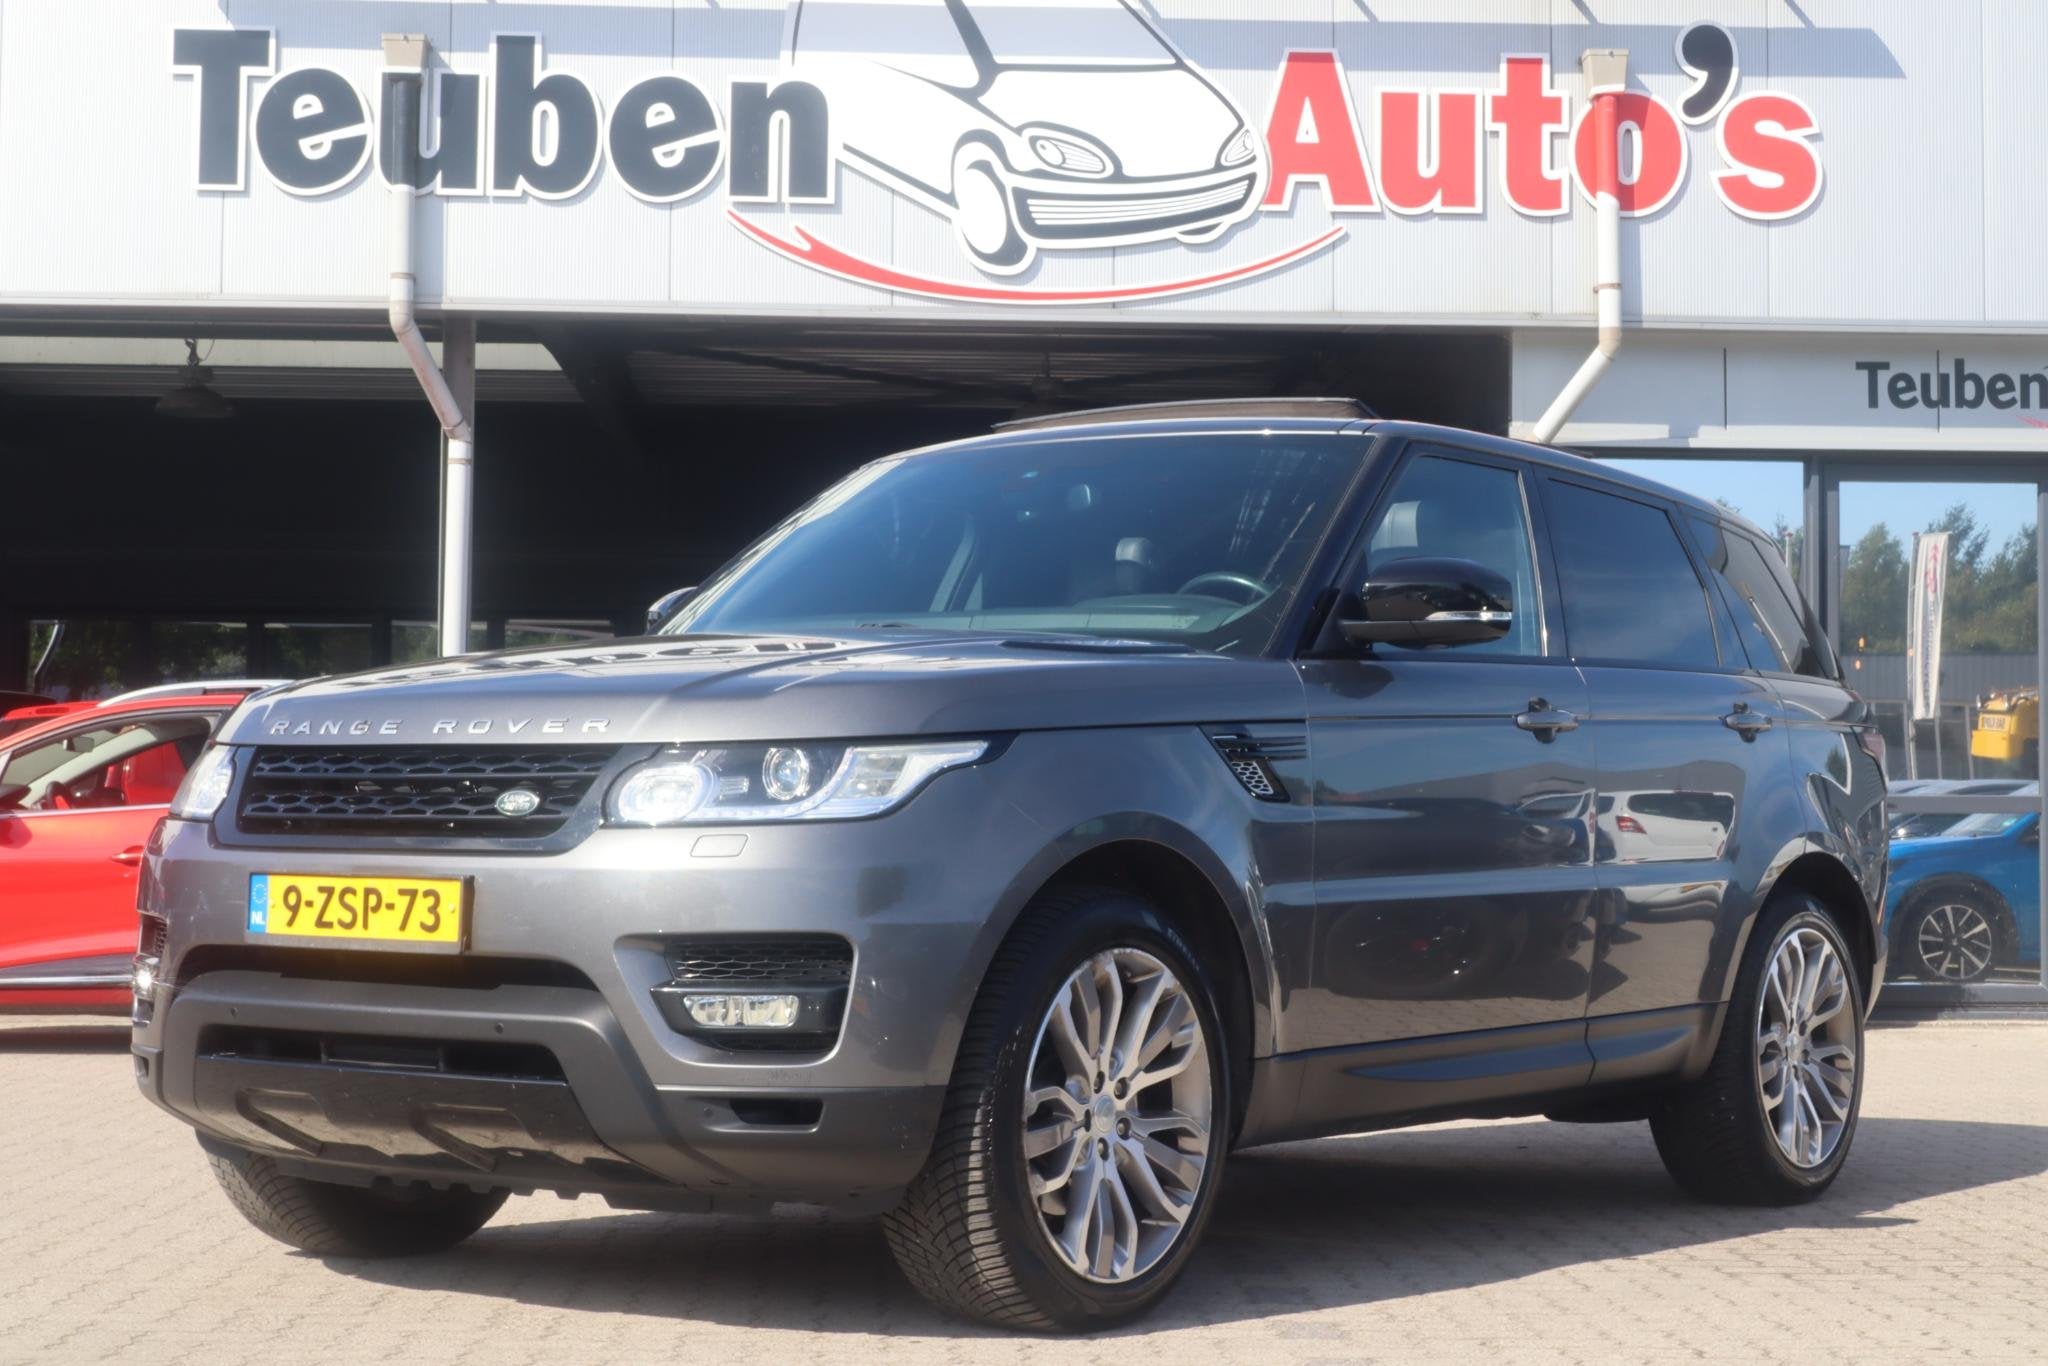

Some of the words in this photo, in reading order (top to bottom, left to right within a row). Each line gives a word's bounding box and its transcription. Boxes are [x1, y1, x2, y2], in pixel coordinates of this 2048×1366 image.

[173, 29, 830, 199] Teuben
[1264, 26, 1818, 213] Auto's
[1855, 358, 2048, 410] Teuben
[270, 719, 402, 735] RANGE
[432, 717, 611, 734] ROVER
[251, 910, 265, 926] NL
[283, 884, 441, 933] 9-ZSP-73
